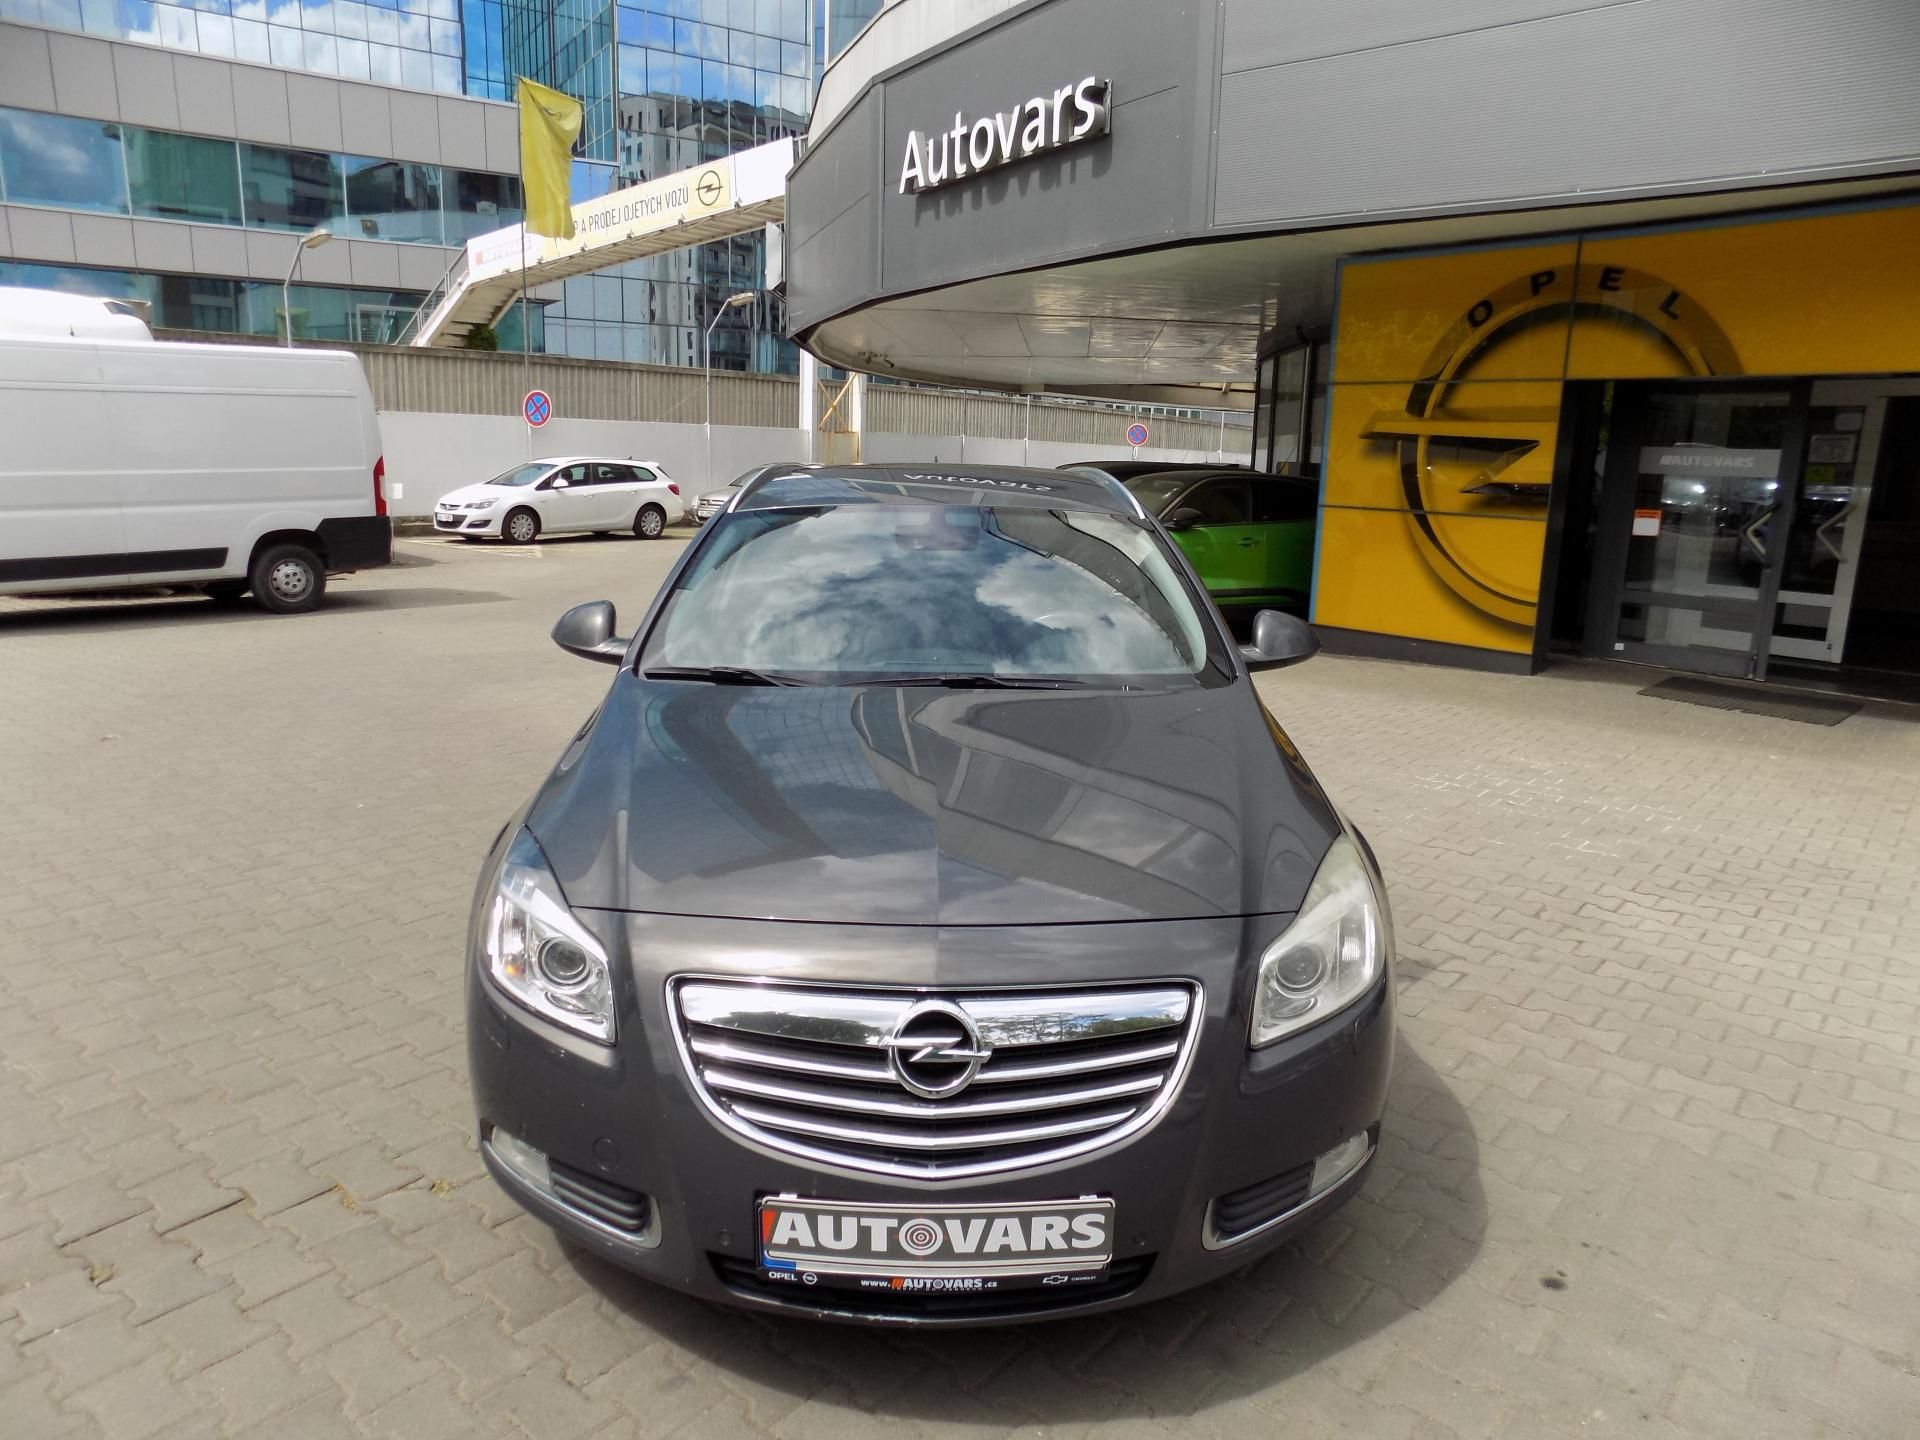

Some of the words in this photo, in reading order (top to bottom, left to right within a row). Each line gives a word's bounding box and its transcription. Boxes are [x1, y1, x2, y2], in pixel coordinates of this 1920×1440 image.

[898, 76, 1104, 195] Autovars
[581, 218, 587, 235] A
[588, 206, 621, 232] PRODEJ
[1467, 267, 1681, 328] OPEL
[771, 1211, 1106, 1255] AUTOVARS
[768, 1271, 797, 1281] OPEL
